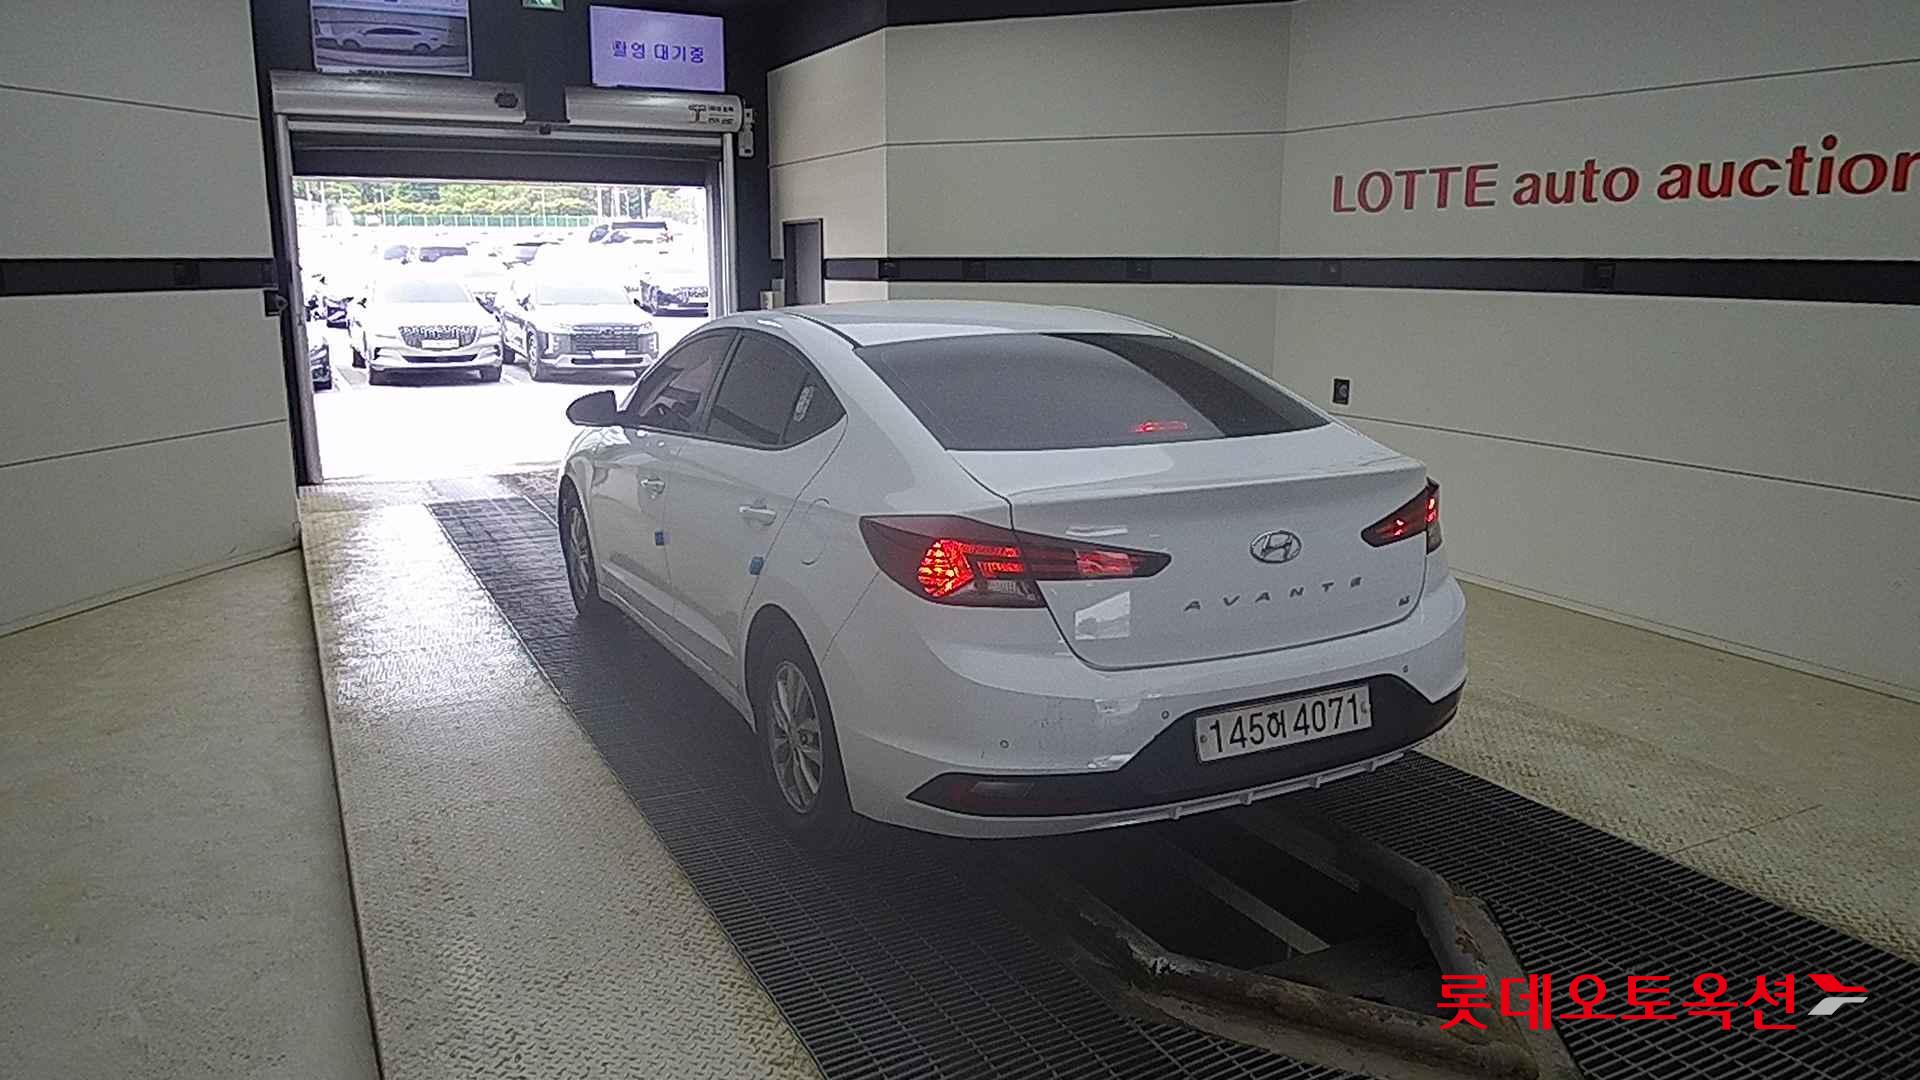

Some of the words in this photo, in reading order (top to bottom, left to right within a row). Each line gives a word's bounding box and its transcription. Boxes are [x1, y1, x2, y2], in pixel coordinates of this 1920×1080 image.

[654, 43, 705, 64] 대기중
[1332, 162, 1499, 213] LOTTE
[1512, 159, 1640, 206] auto
[1183, 576, 1363, 612] AVANTE
